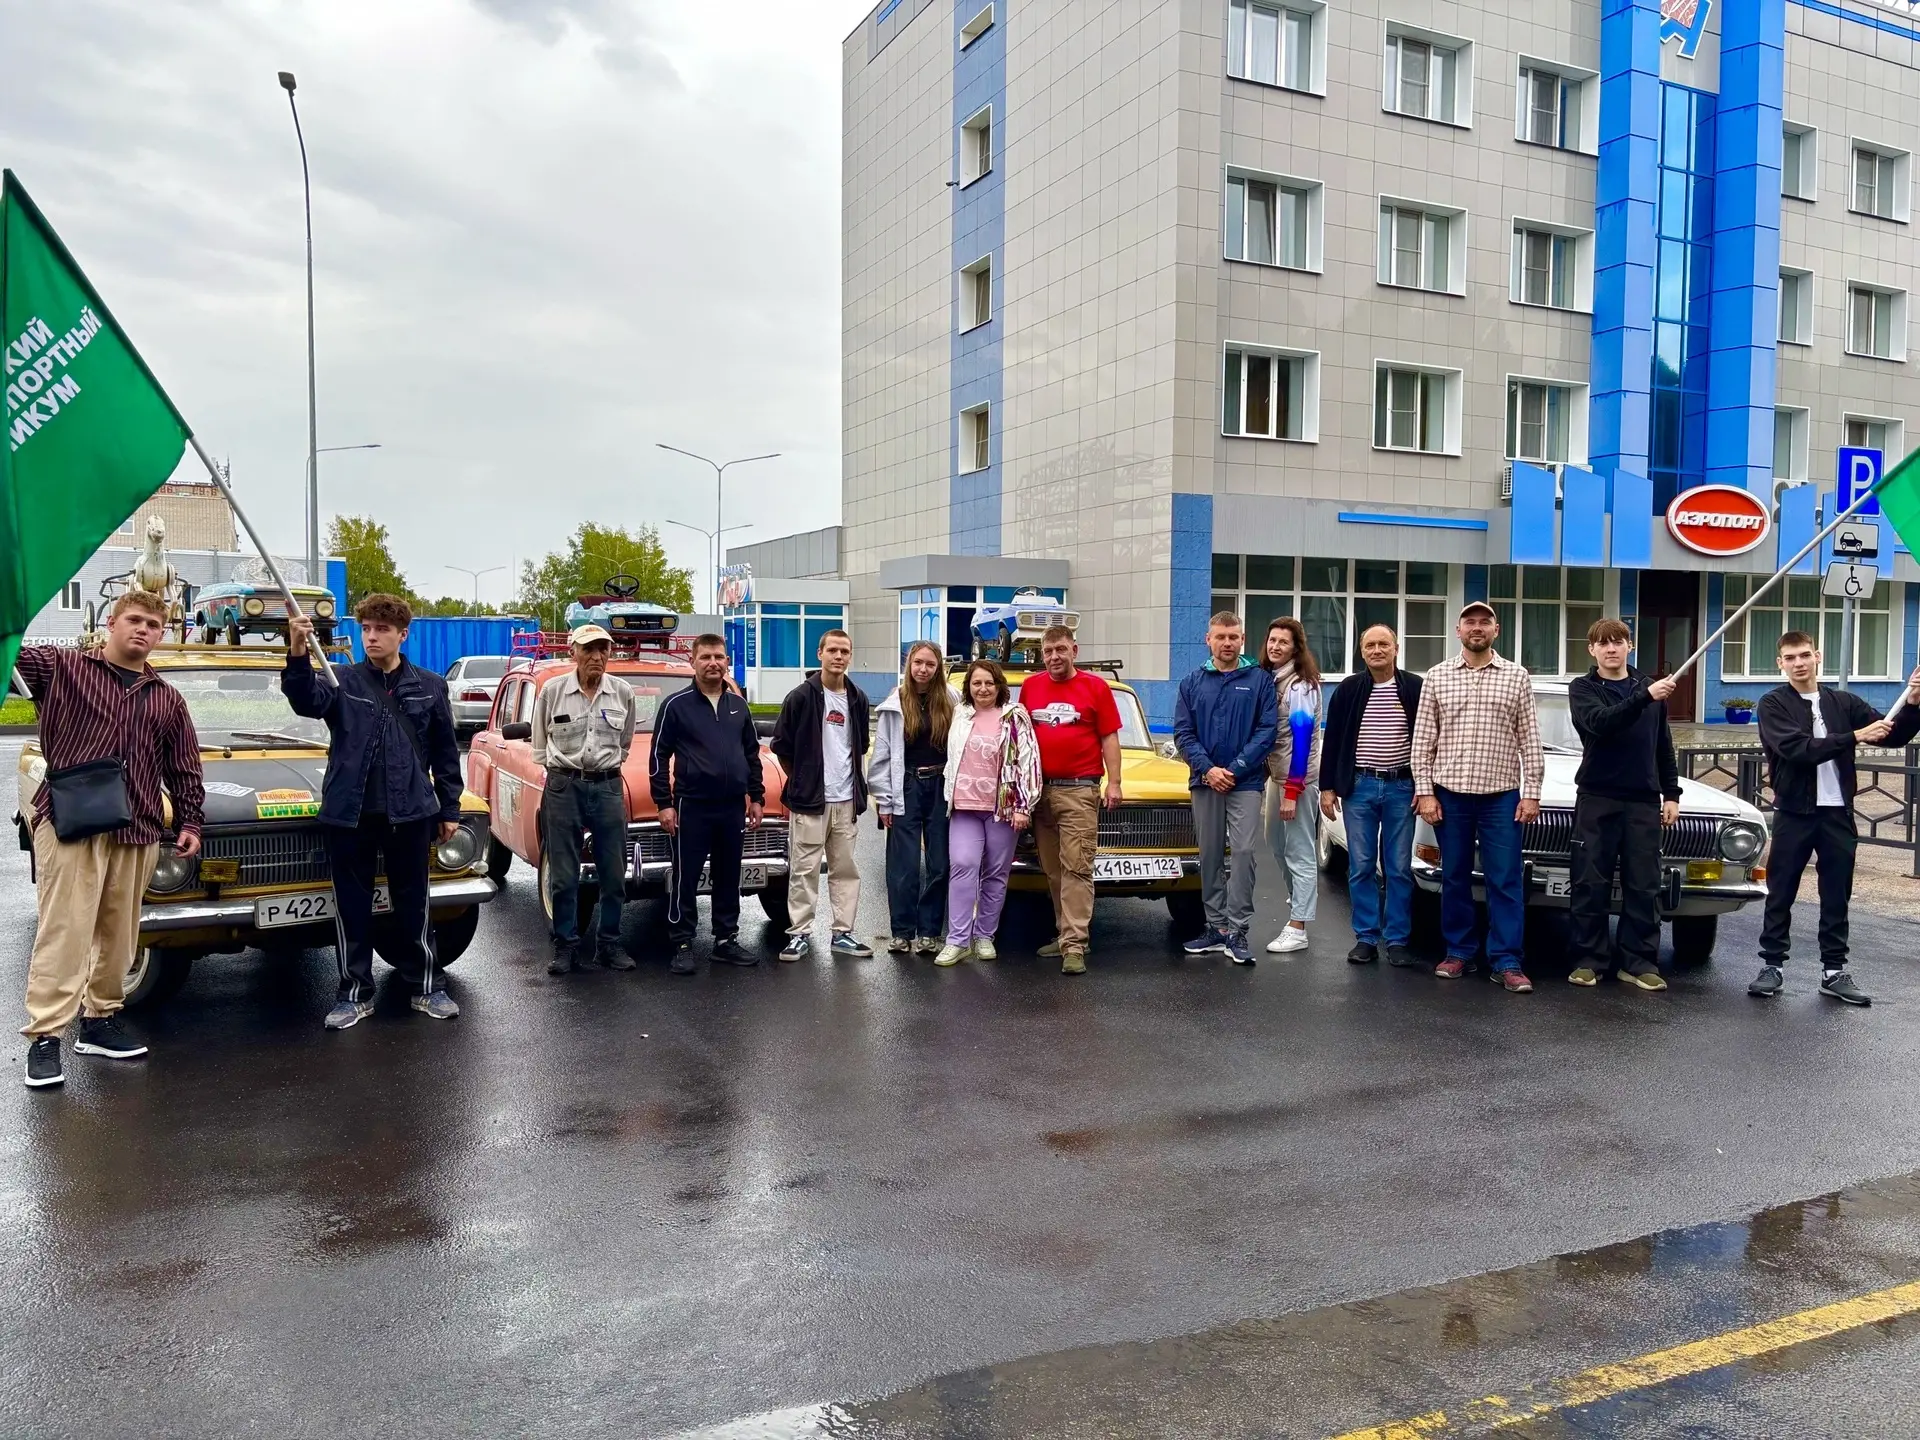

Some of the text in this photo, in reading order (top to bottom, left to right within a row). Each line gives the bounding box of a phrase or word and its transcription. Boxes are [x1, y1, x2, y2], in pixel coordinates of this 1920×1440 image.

[6, 305, 102, 417] ПОРТНЫЙ
[10, 373, 81, 452] ИКУМ
[1675, 511, 1764, 530] АЭРОПОРТ
[744, 868, 761, 880] 22
[1154, 859, 1176, 871] 122
